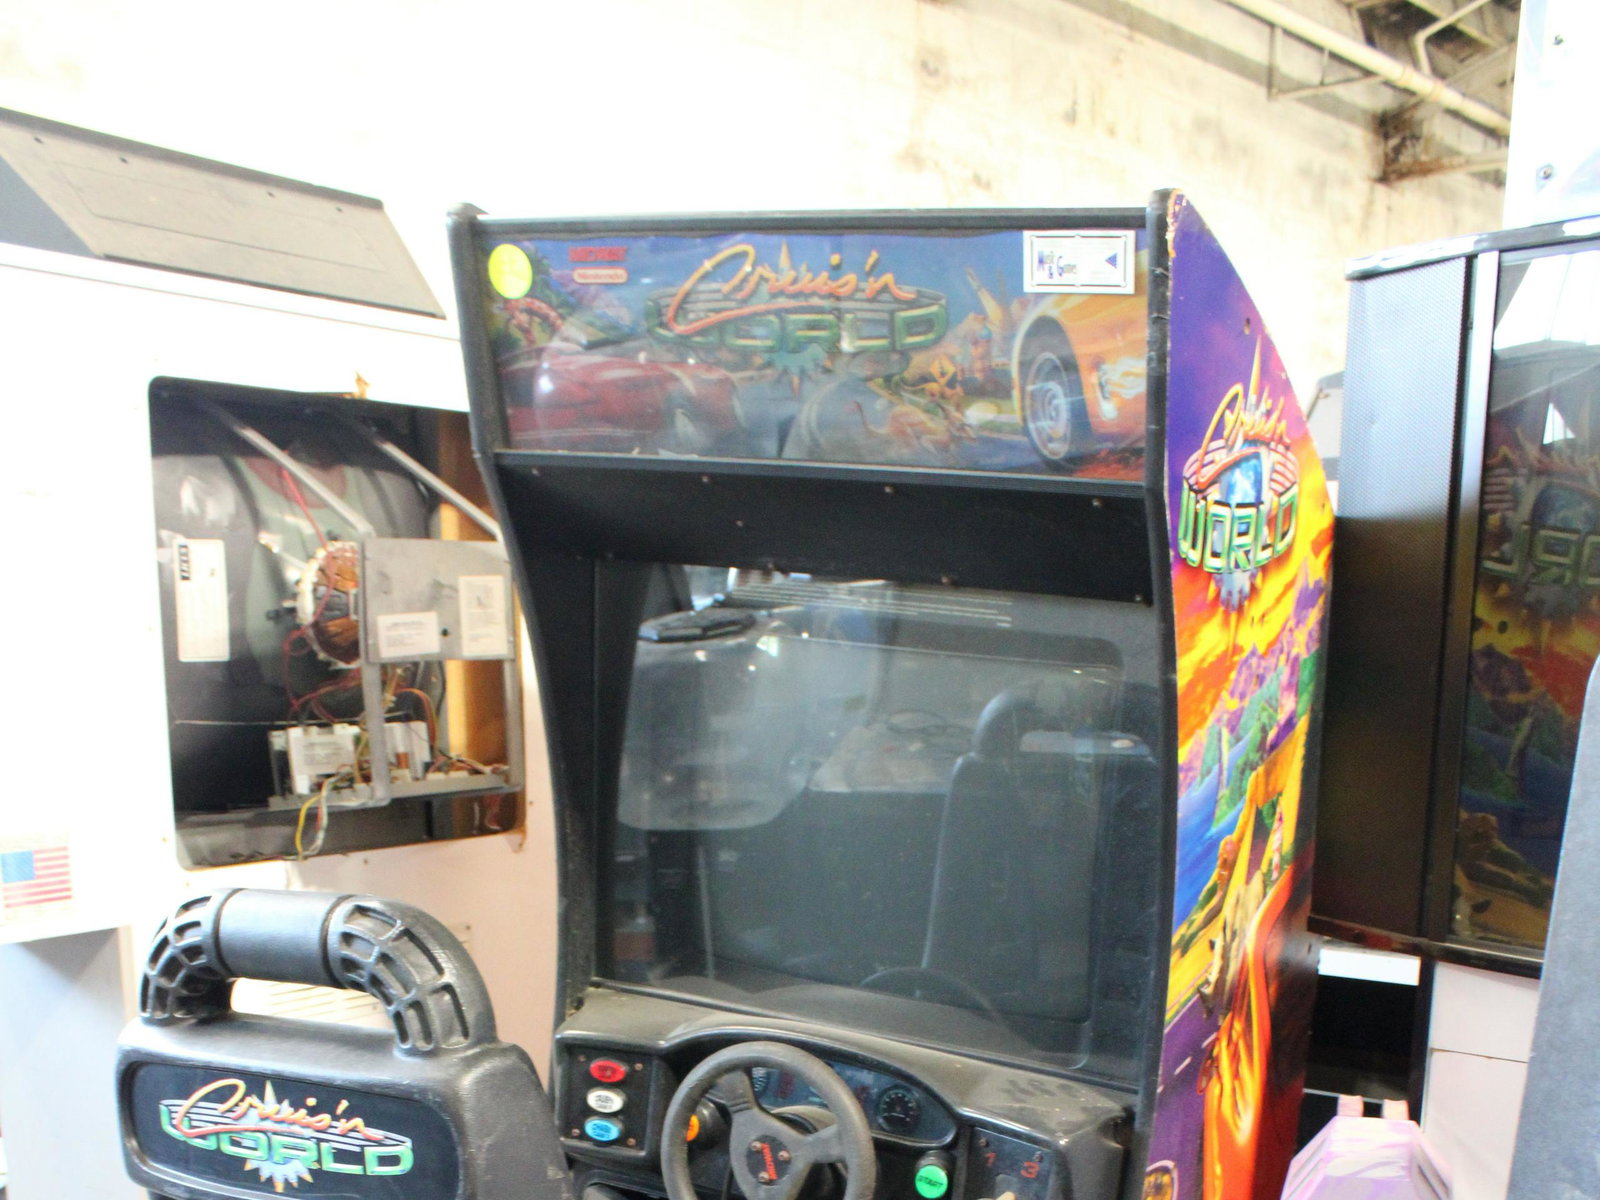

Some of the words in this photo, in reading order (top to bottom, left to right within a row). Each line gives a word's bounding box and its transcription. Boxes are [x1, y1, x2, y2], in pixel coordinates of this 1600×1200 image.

[666, 243, 917, 335] Cruis'n
[645, 298, 947, 353] WORLD
[1178, 481, 1298, 574] WORLD
[175, 1078, 384, 1136] Cruis'n
[159, 1103, 414, 1176] WORLD
[918, 1175, 943, 1189] START
[1021, 1161, 1040, 1178] 3
